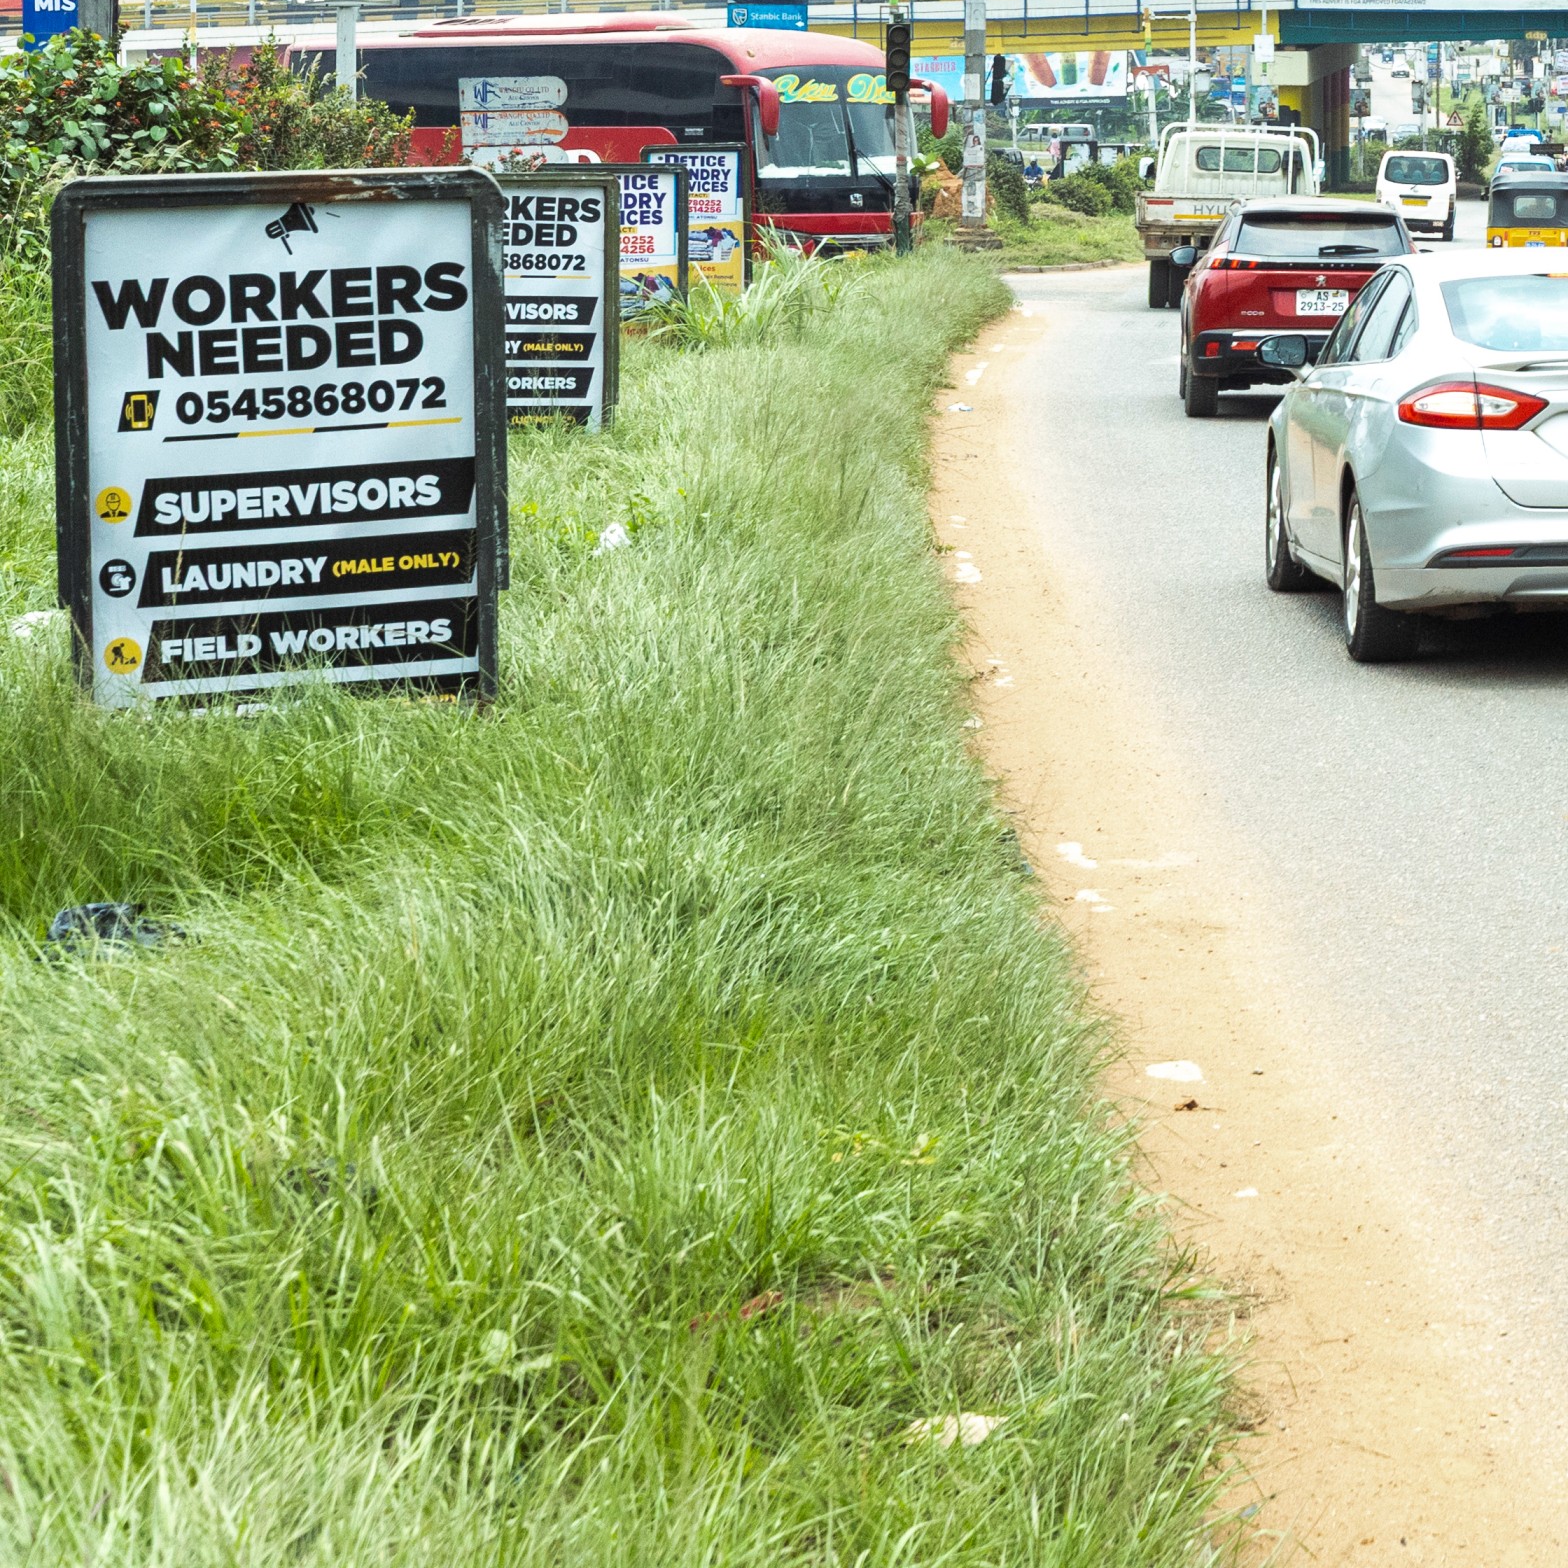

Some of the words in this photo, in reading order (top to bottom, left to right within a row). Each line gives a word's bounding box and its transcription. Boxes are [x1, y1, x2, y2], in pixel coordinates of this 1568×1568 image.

[750, 12, 780, 20] Stanbic
[782, 13, 803, 21] Bank
[773, 74, 839, 104] Yesu
[620, 245, 655, 254] 4256
[91, 261, 469, 331] WORKERS
[1300, 302, 1345, 312] 2913-25
[1316, 291, 1329, 301] AS
[146, 318, 424, 380] NEEDED
[522, 343, 554, 353] (MALE
[554, 343, 584, 353] ONLY)
[506, 376, 577, 391] ORKERS
[176, 376, 448, 425] 0545868072
[154, 474, 442, 526] SUPERVISORS
[161, 556, 328, 594] LAUNDRY
[332, 556, 395, 578] (MALE
[398, 551, 461, 571] ONLY)
[161, 632, 262, 665] FIELD
[270, 618, 453, 656] WORKERS
